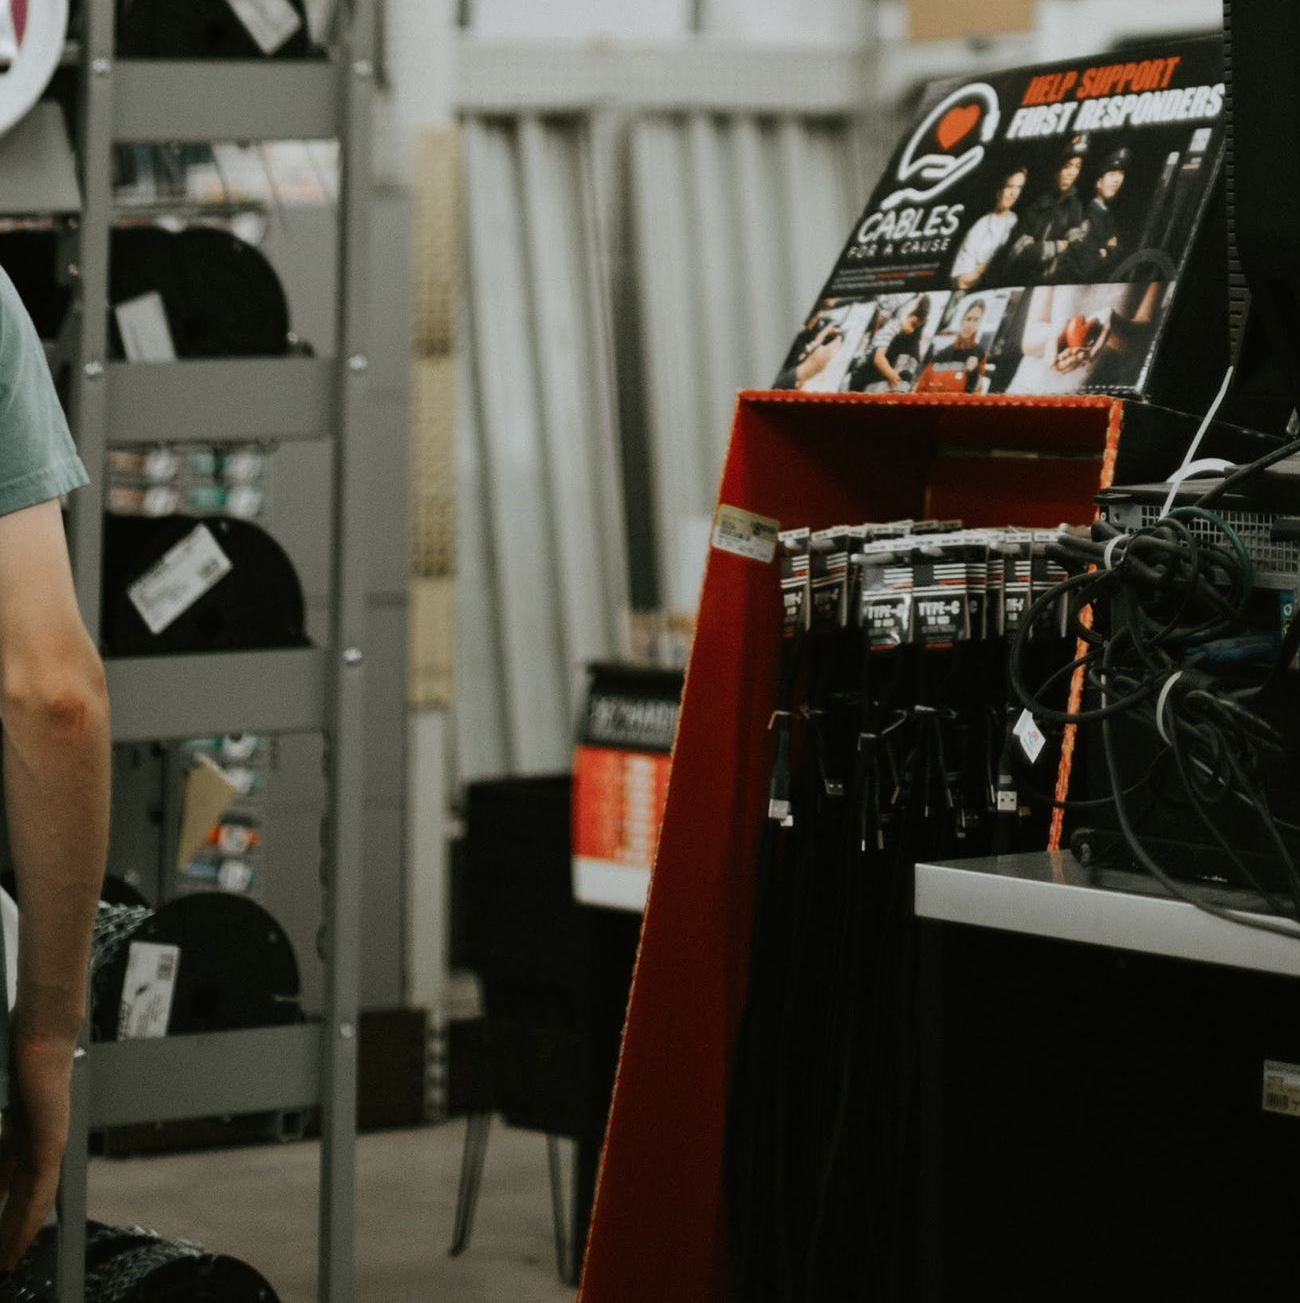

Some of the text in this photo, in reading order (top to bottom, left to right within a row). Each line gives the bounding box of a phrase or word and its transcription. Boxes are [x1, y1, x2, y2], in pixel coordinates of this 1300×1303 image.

[1021, 56, 1181, 106] HELP SUPPORT
[1005, 83, 1225, 139] FIRST RESPONDERS
[858, 204, 965, 243] CABLES
[847, 238, 951, 259] FOR A CAUSE
[918, 600, 960, 616] TYPE-C
